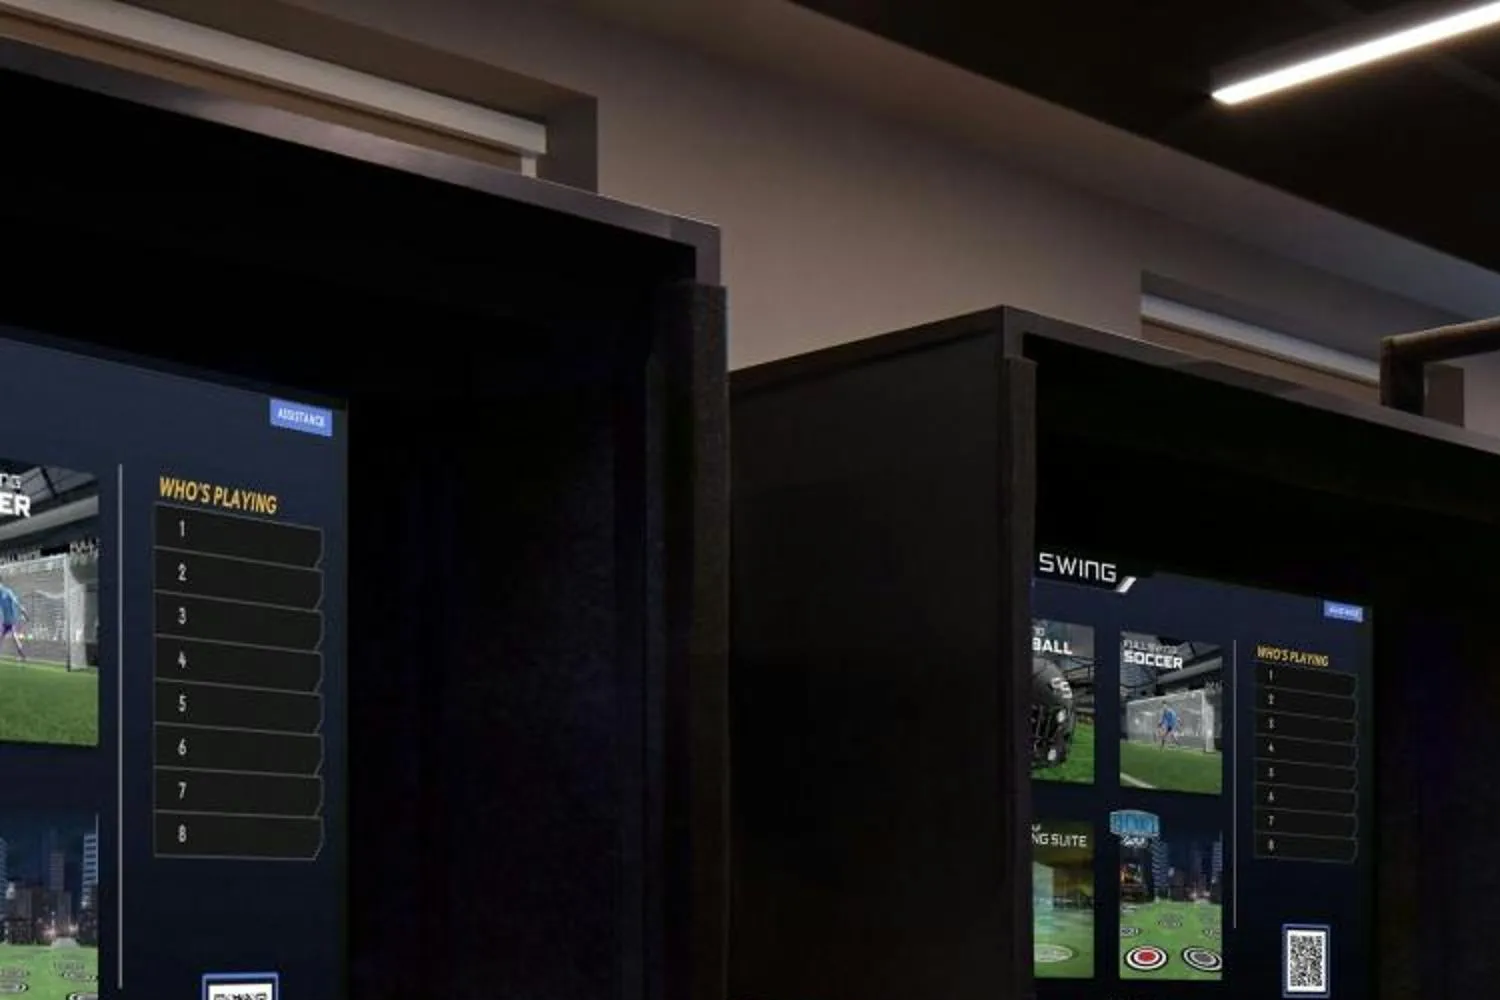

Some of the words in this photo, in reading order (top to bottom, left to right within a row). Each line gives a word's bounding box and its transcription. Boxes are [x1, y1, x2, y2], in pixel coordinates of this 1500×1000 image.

[159, 475, 212, 503] WHO'S
[213, 485, 278, 515] PLAYING
[178, 519, 185, 537] 1
[178, 563, 187, 581] 2
[1039, 551, 1117, 583] SWING
[178, 607, 187, 624] 3
[178, 651, 187, 669] 4
[1123, 649, 1184, 671] SOCCER
[178, 695, 187, 712] 5
[178, 738, 187, 756] 6
[178, 781, 187, 800] 7
[178, 824, 187, 843] 8
